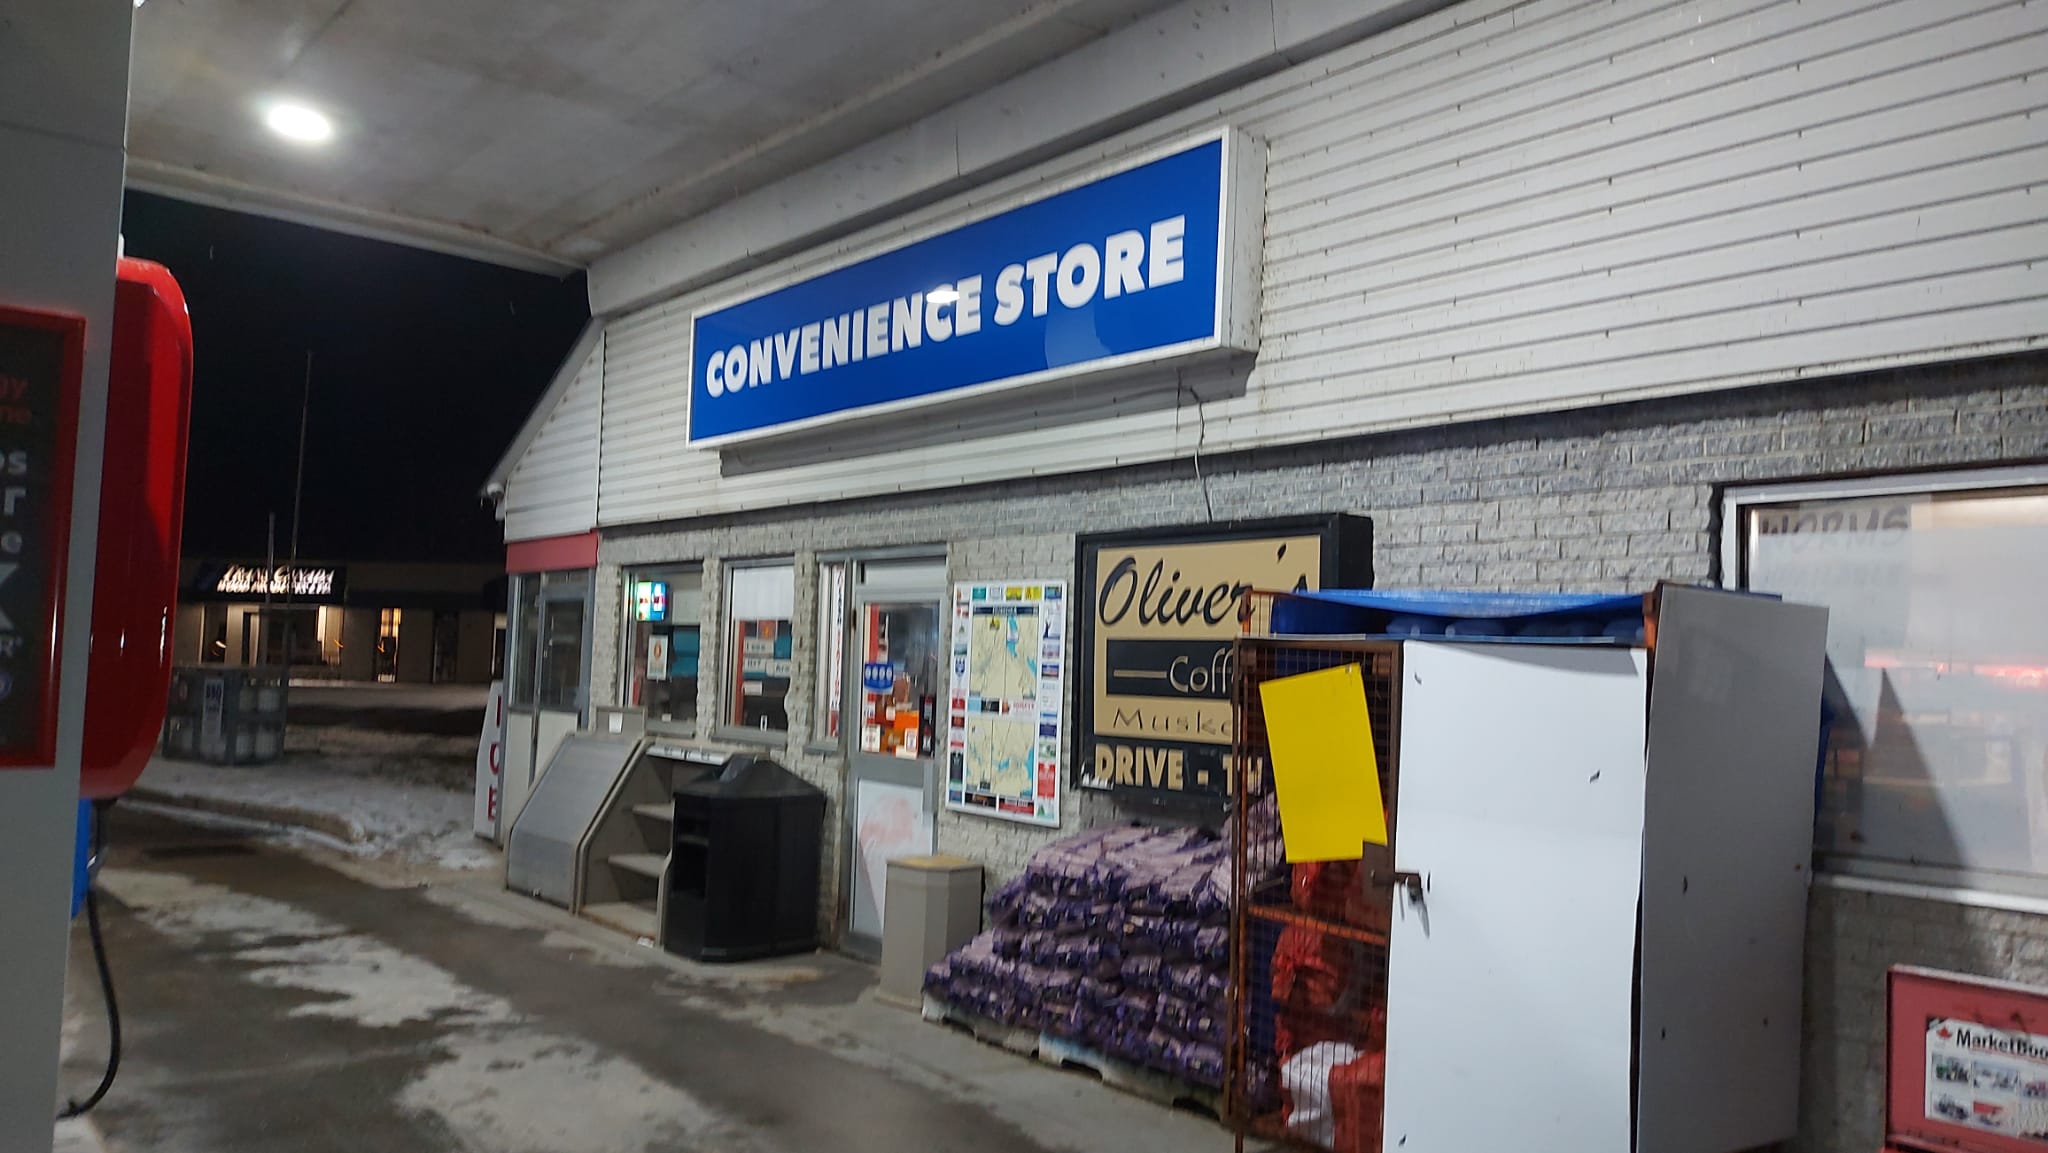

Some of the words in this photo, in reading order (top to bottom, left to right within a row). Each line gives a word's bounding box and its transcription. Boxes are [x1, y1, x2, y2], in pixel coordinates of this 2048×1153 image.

[706, 273, 982, 398] CONVENIENCE
[993, 213, 1186, 327] STORE
[1099, 543, 1309, 626] Oliver'
[1094, 743, 1184, 791] DRIVE
